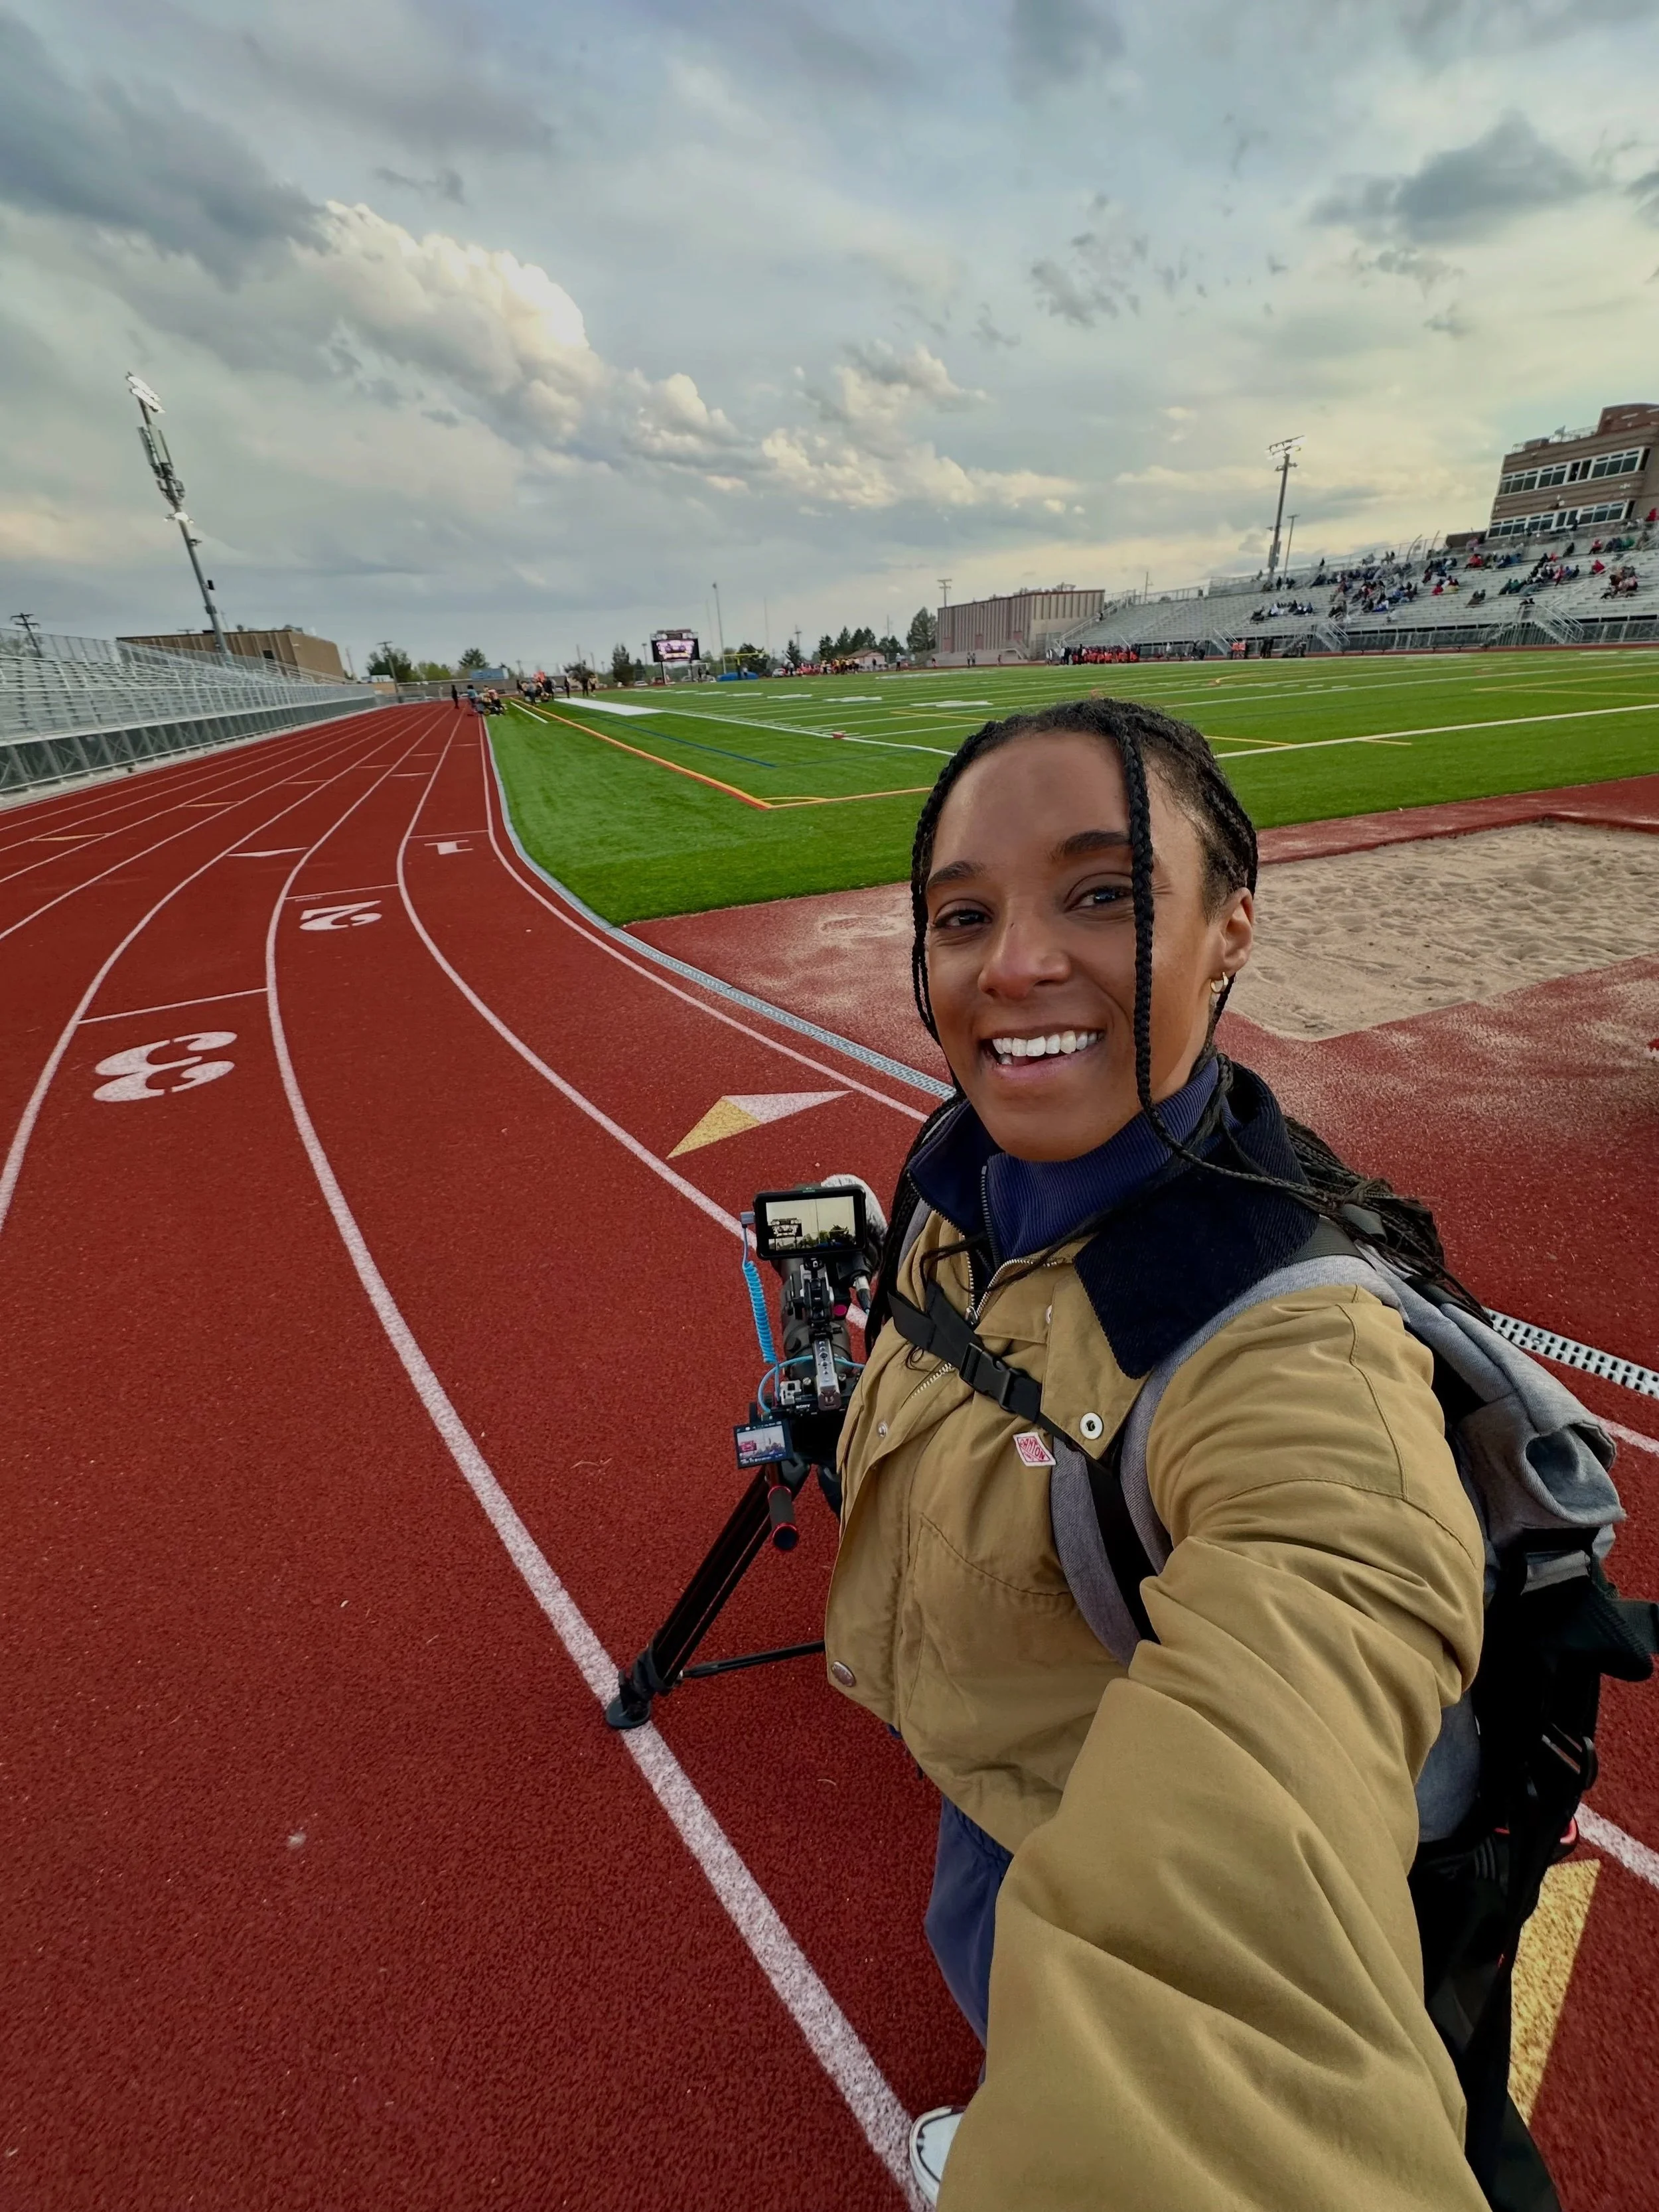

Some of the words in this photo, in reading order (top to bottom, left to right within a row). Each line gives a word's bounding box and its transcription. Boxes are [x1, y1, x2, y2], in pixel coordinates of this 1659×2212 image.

[424, 840, 474, 855] 1
[299, 901, 382, 930] 2
[93, 1031, 238, 1102] 3
[1020, 1438, 1045, 1460] DANTON
